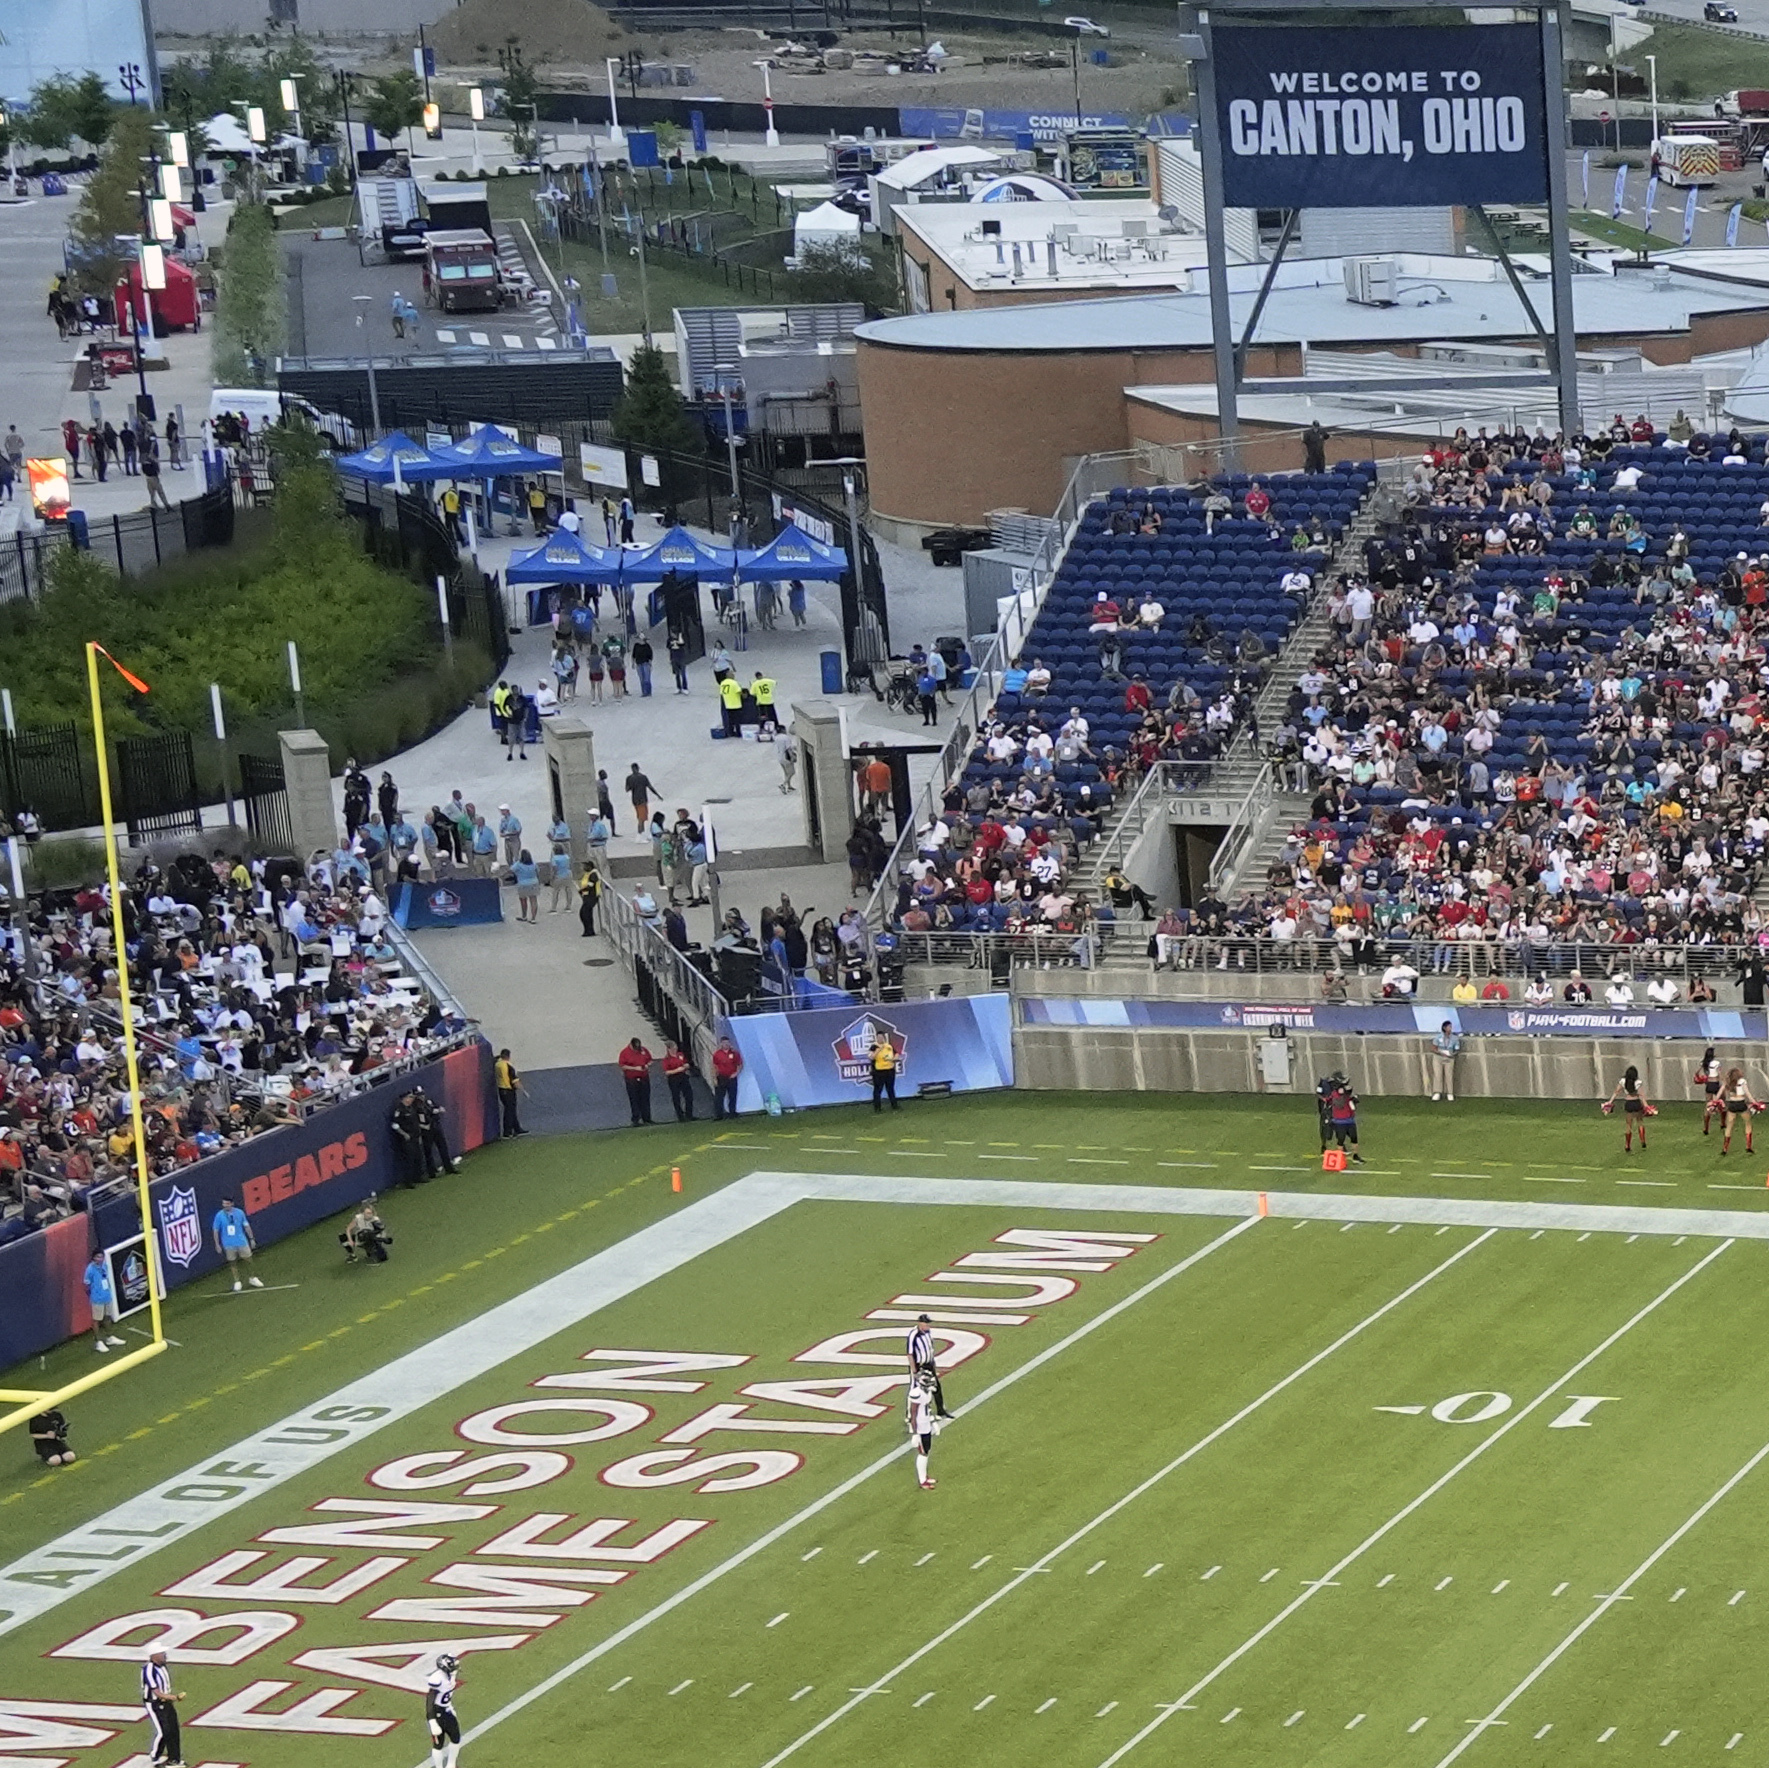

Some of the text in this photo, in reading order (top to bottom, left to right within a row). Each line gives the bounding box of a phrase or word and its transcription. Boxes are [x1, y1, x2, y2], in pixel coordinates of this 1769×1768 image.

[1229, 96, 1526, 162] CANTON, OHIO
[1269, 70, 1481, 93] WELCOME TO
[166, 1216, 199, 1256] NFL
[241, 1134, 369, 1217] BEARS
[599, 1227, 1164, 1495] STADIUM
[7, 1404, 394, 1590] ALL OF US
[46, 1348, 758, 1665] BENSON
[187, 1513, 719, 1735] FAME
